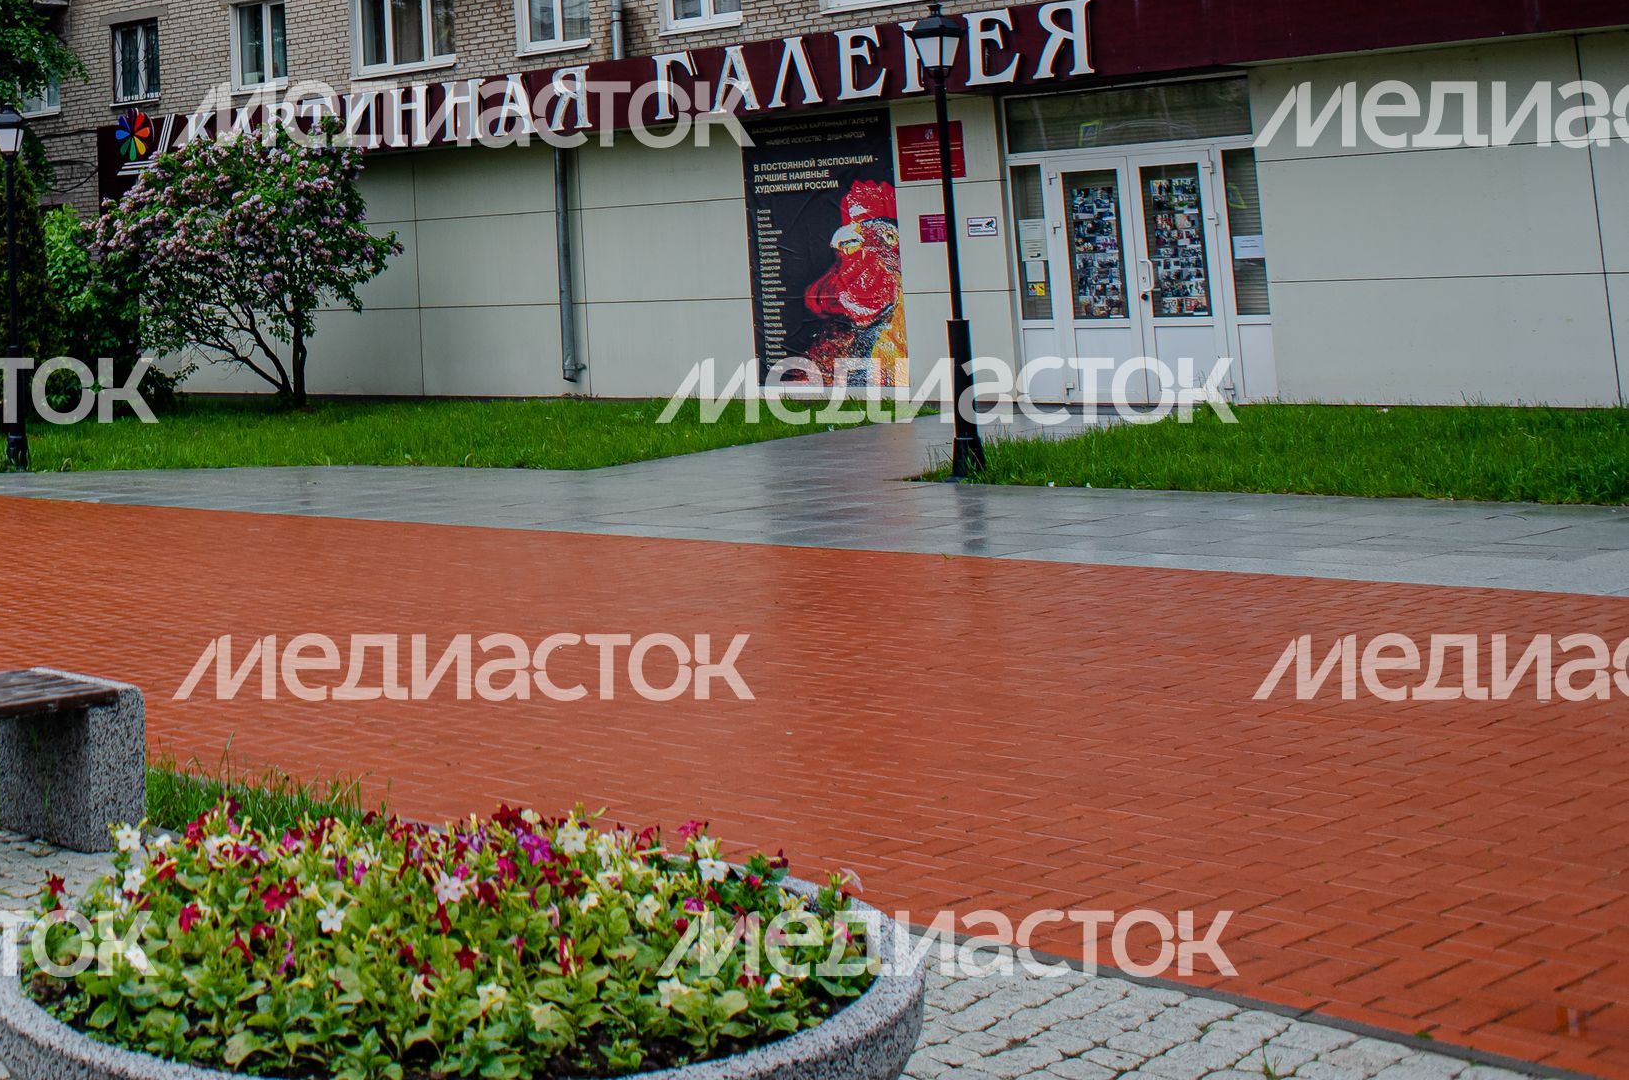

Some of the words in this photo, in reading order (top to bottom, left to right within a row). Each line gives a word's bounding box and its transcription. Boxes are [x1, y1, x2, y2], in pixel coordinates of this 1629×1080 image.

[809, 119, 848, 129] КАРТИННАЯ
[849, 116, 879, 126] ГАЛЕРЕЯ
[791, 135, 822, 144] ИСКУССТВО
[844, 130, 866, 139] НАРОДА
[754, 164, 759, 172] В
[761, 159, 816, 171] ПОСТОЯННОЙ
[817, 155, 873, 168] ЭКСПОЗИЦИИ
[754, 173, 787, 183] ЛУЧШИЕ
[789, 170, 830, 180] НАИВНЫЕ
[755, 182, 804, 194] ХУДОЖНИКИ
[805, 180, 839, 190] РОССИИ
